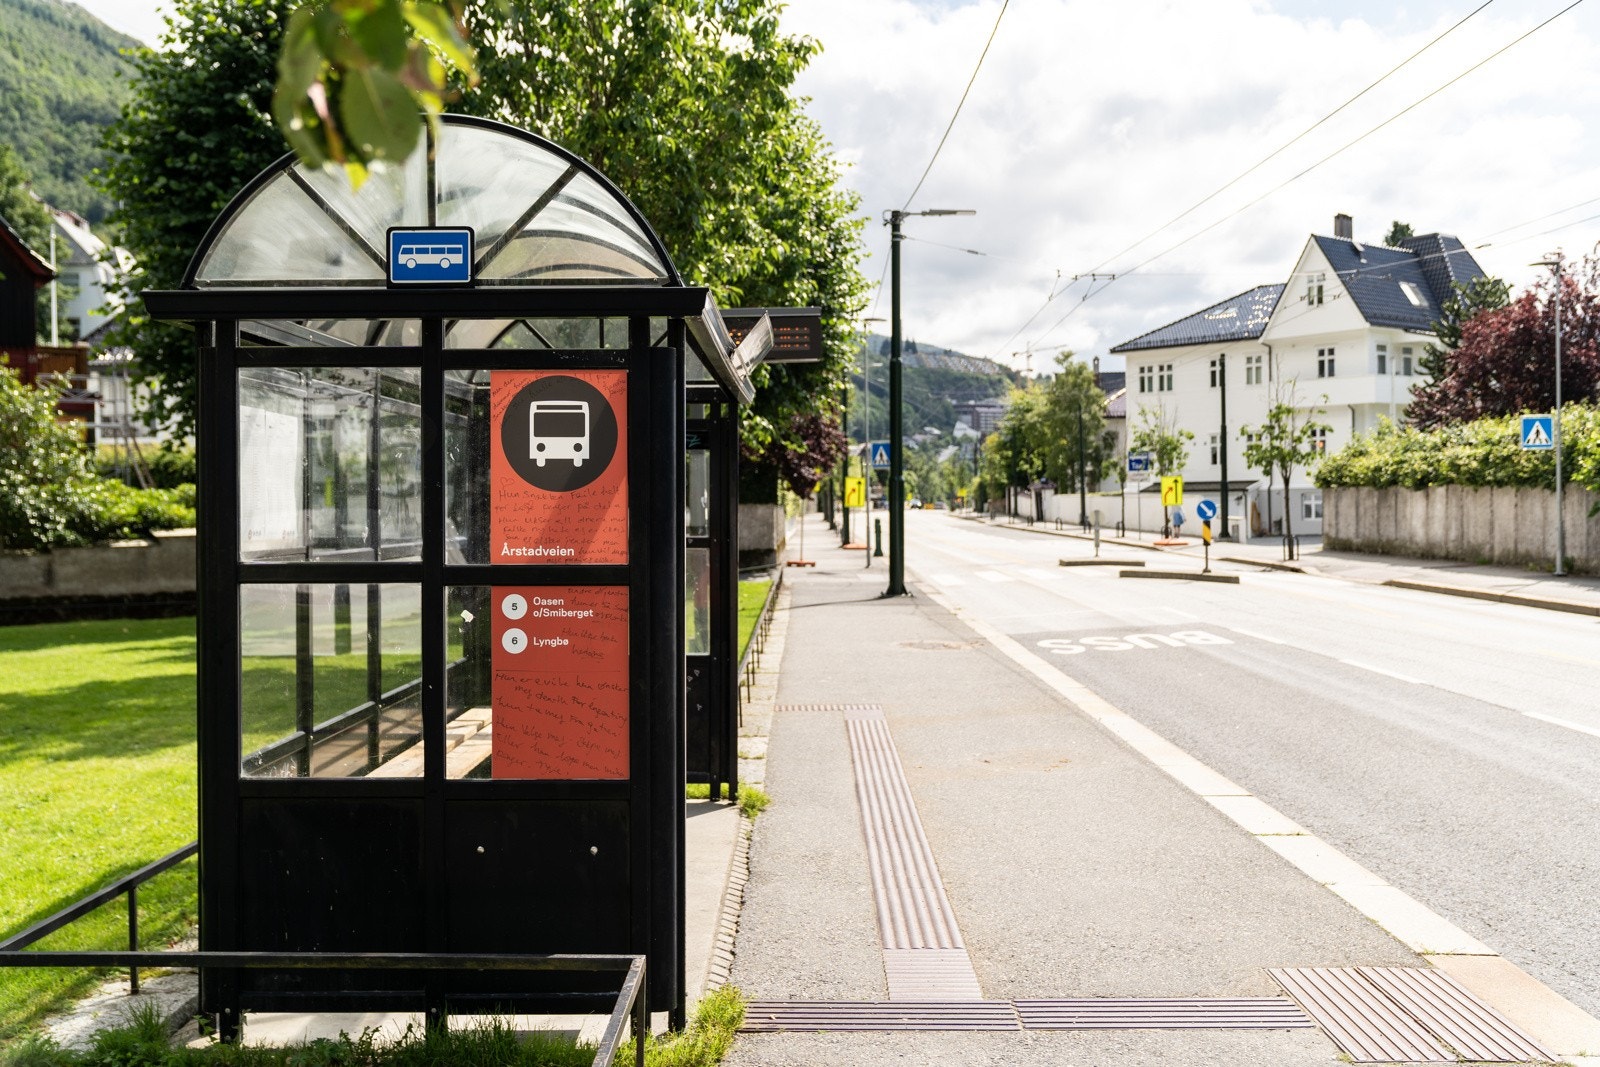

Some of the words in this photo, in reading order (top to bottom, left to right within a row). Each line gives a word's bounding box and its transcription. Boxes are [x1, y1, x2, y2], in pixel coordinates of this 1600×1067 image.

[501, 542, 575, 556] Årstadveien
[533, 596, 564, 606] Oasen
[511, 603, 518, 611] 5
[533, 608, 594, 618] o/Smiberget
[511, 637, 518, 645] 6
[533, 636, 569, 648] Lyngbø
[1036, 630, 1235, 655] BUSS
